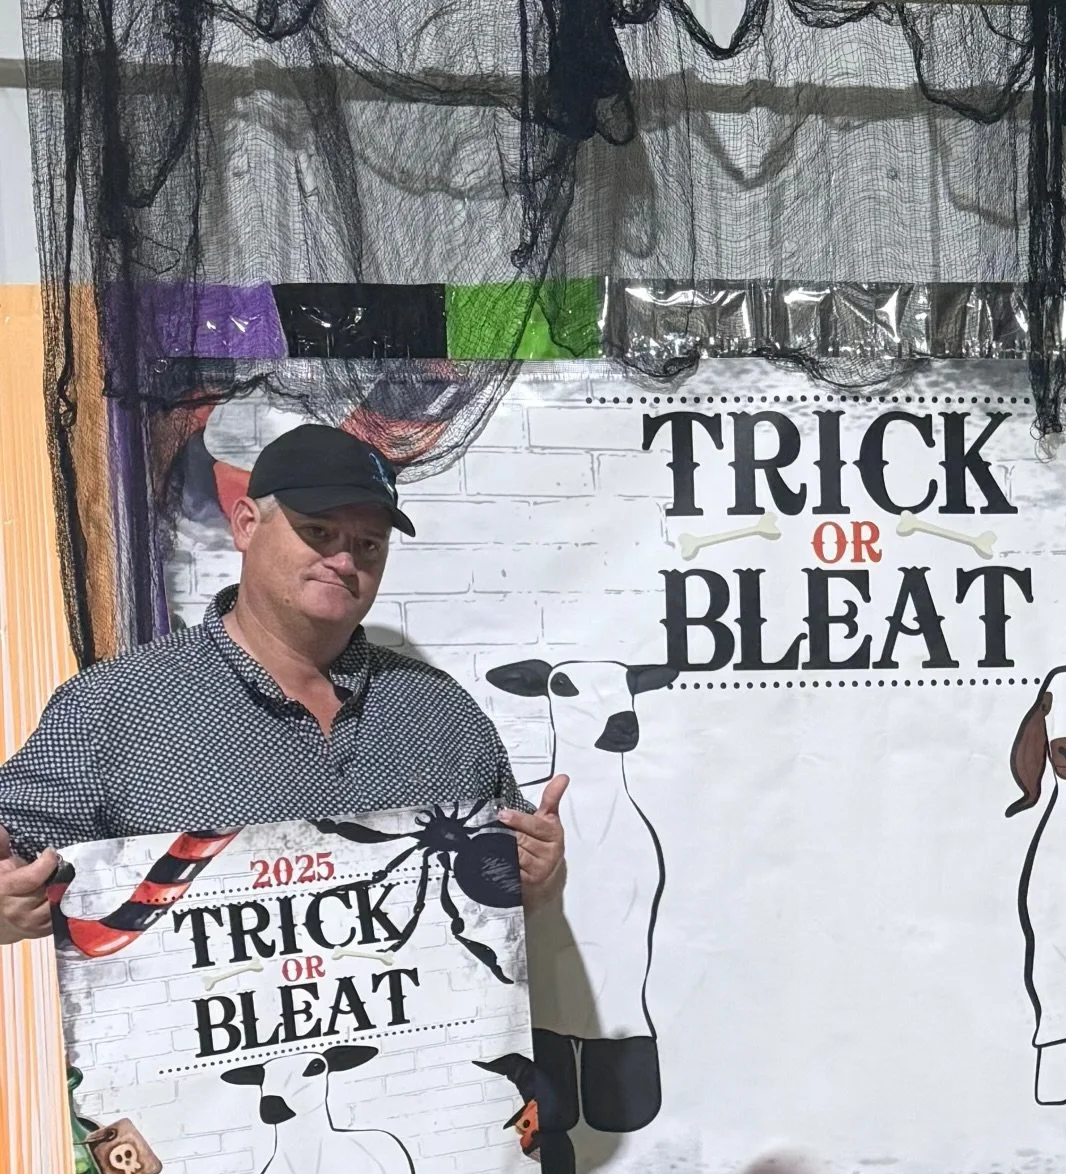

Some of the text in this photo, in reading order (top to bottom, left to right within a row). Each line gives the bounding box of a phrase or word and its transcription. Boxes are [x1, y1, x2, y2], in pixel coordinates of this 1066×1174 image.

[642, 409, 1018, 516] TRICK
[811, 521, 882, 563] OR
[658, 565, 1034, 671] BLEAT
[250, 852, 335, 889] 2025
[172, 883, 403, 969] TRICK
[281, 955, 325, 982] OR
[192, 968, 420, 1058] BLEAT
